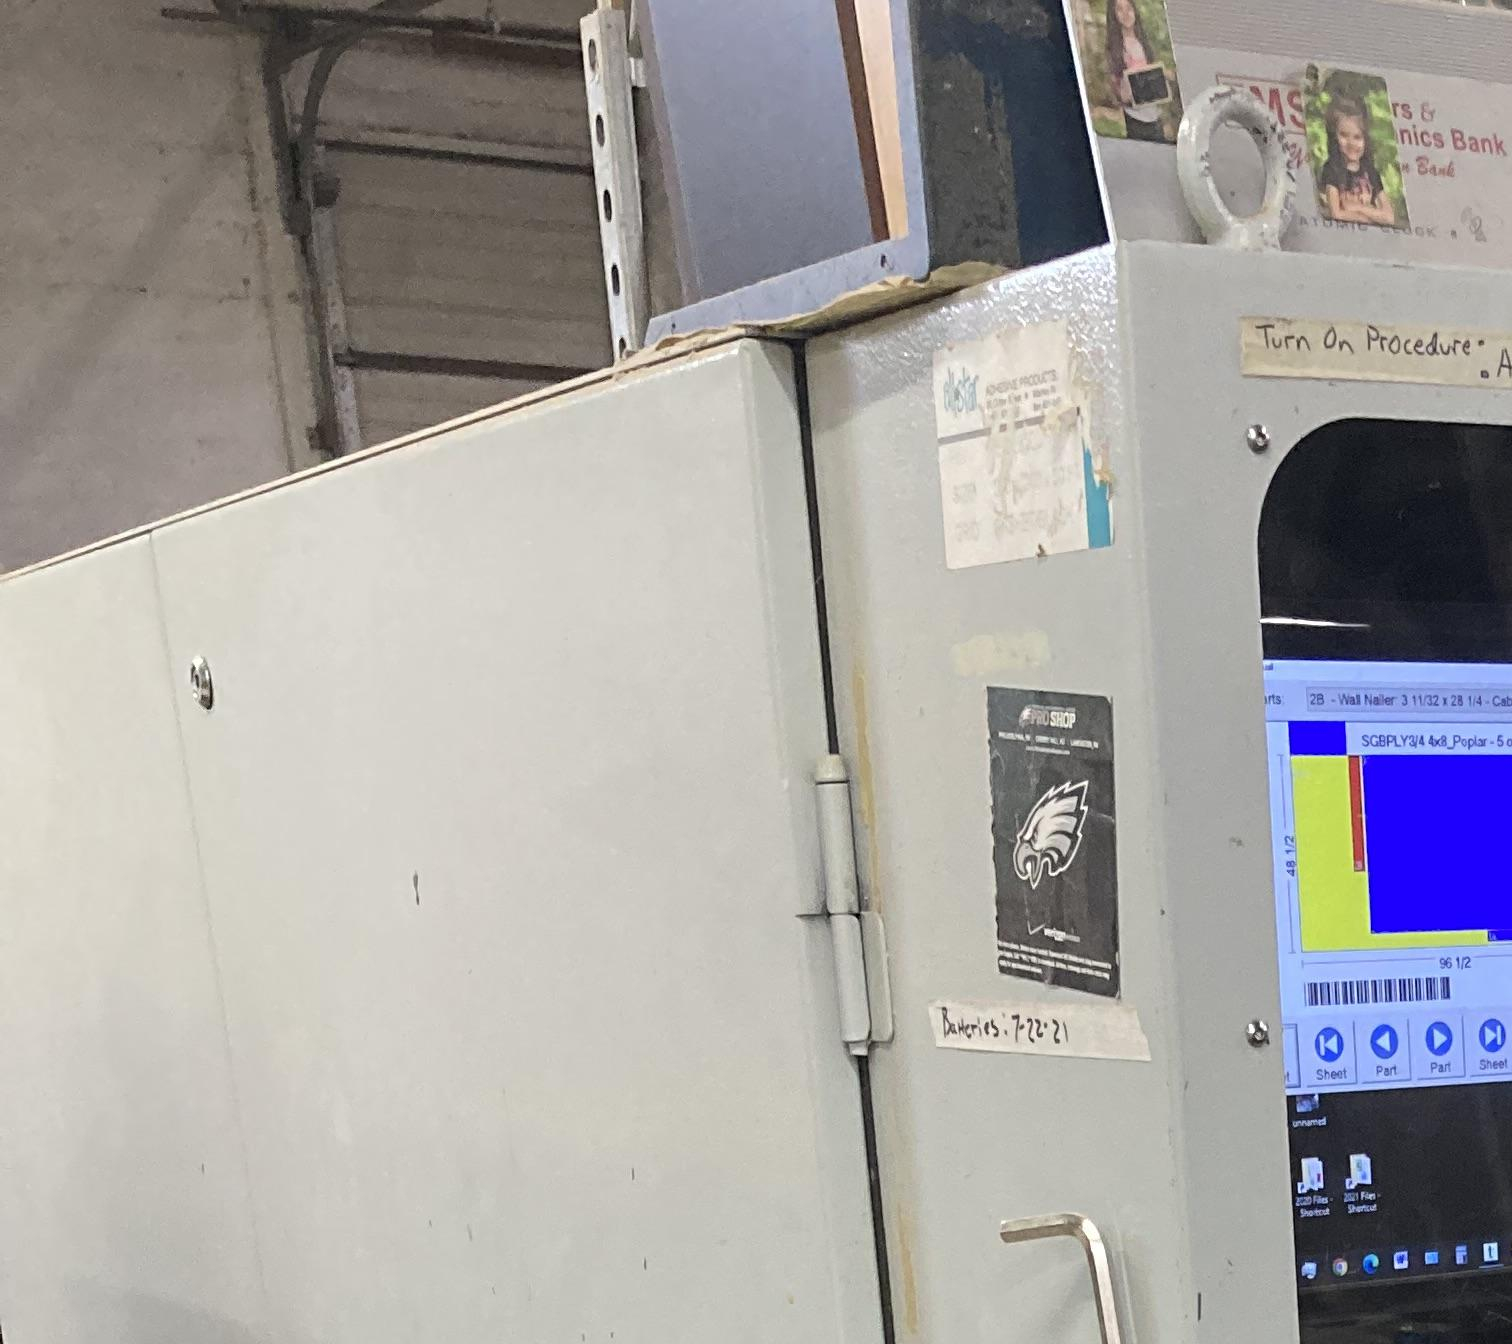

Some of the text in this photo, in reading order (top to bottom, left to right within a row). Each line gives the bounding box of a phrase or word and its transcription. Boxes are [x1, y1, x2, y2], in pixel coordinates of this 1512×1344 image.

[1452, 128, 1507, 156] Bank
[1416, 156, 1456, 178] Bank
[1255, 324, 1311, 352] Turn
[1323, 326, 1354, 353] On
[1338, 693, 1361, 706] Wall
[1412, 694, 1439, 706] 11/32
[1467, 695, 1483, 707] 1/4
[1050, 711, 1076, 729] SHOP
[1284, 835, 1297, 877] 48 1/2
[1439, 956, 1472, 970] 96 1/2
[1316, 1068, 1347, 1081] Sheet
[1376, 1064, 1397, 1078] Part
[1430, 1061, 1451, 1074] Part
[1479, 1057, 1508, 1071] Sheet
